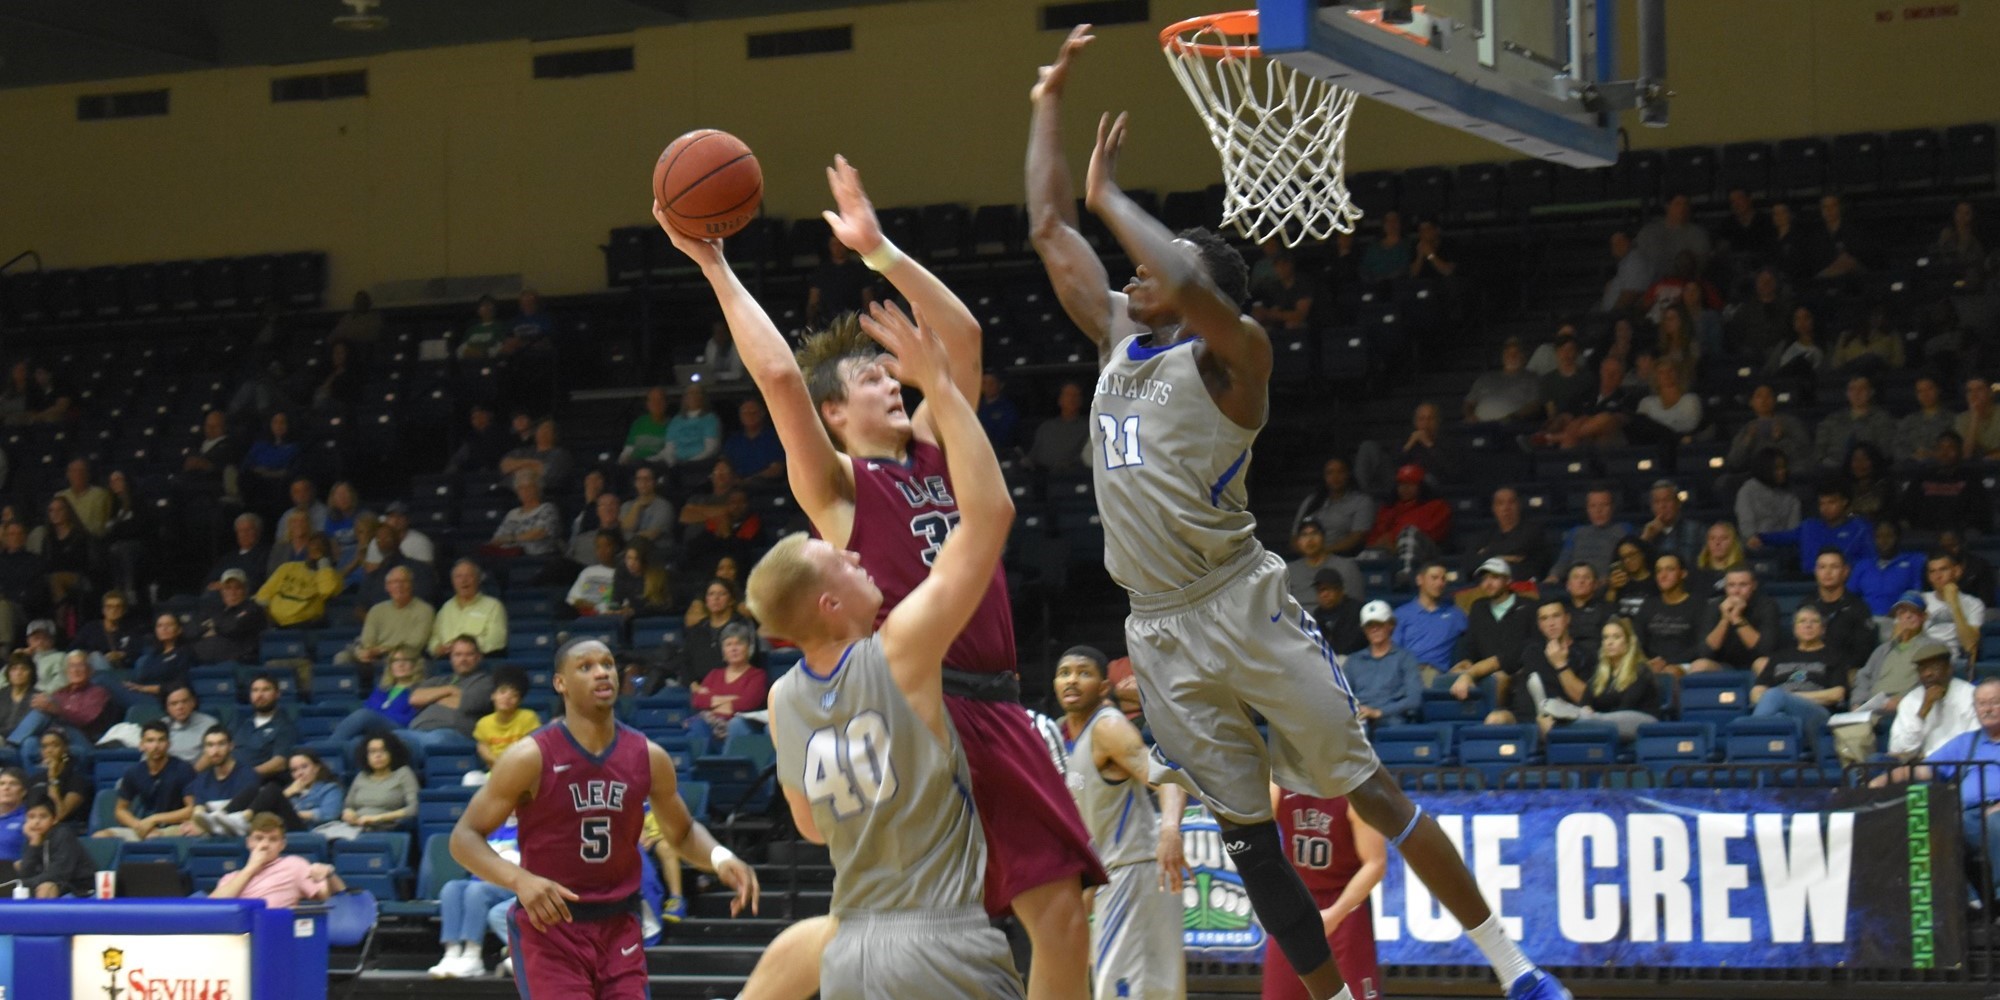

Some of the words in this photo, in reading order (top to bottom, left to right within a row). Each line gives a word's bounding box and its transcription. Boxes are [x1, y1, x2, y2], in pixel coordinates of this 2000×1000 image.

[1098, 413, 1144, 470] 21
[910, 510, 961, 567] 3
[803, 708, 899, 822] 40
[568, 780, 628, 812] LEE
[1291, 807, 1334, 835] LEE
[580, 816, 611, 863] 5
[1292, 834, 1333, 870] 10
[1370, 812, 1524, 943] LUE
[1556, 812, 1855, 943] CREW
